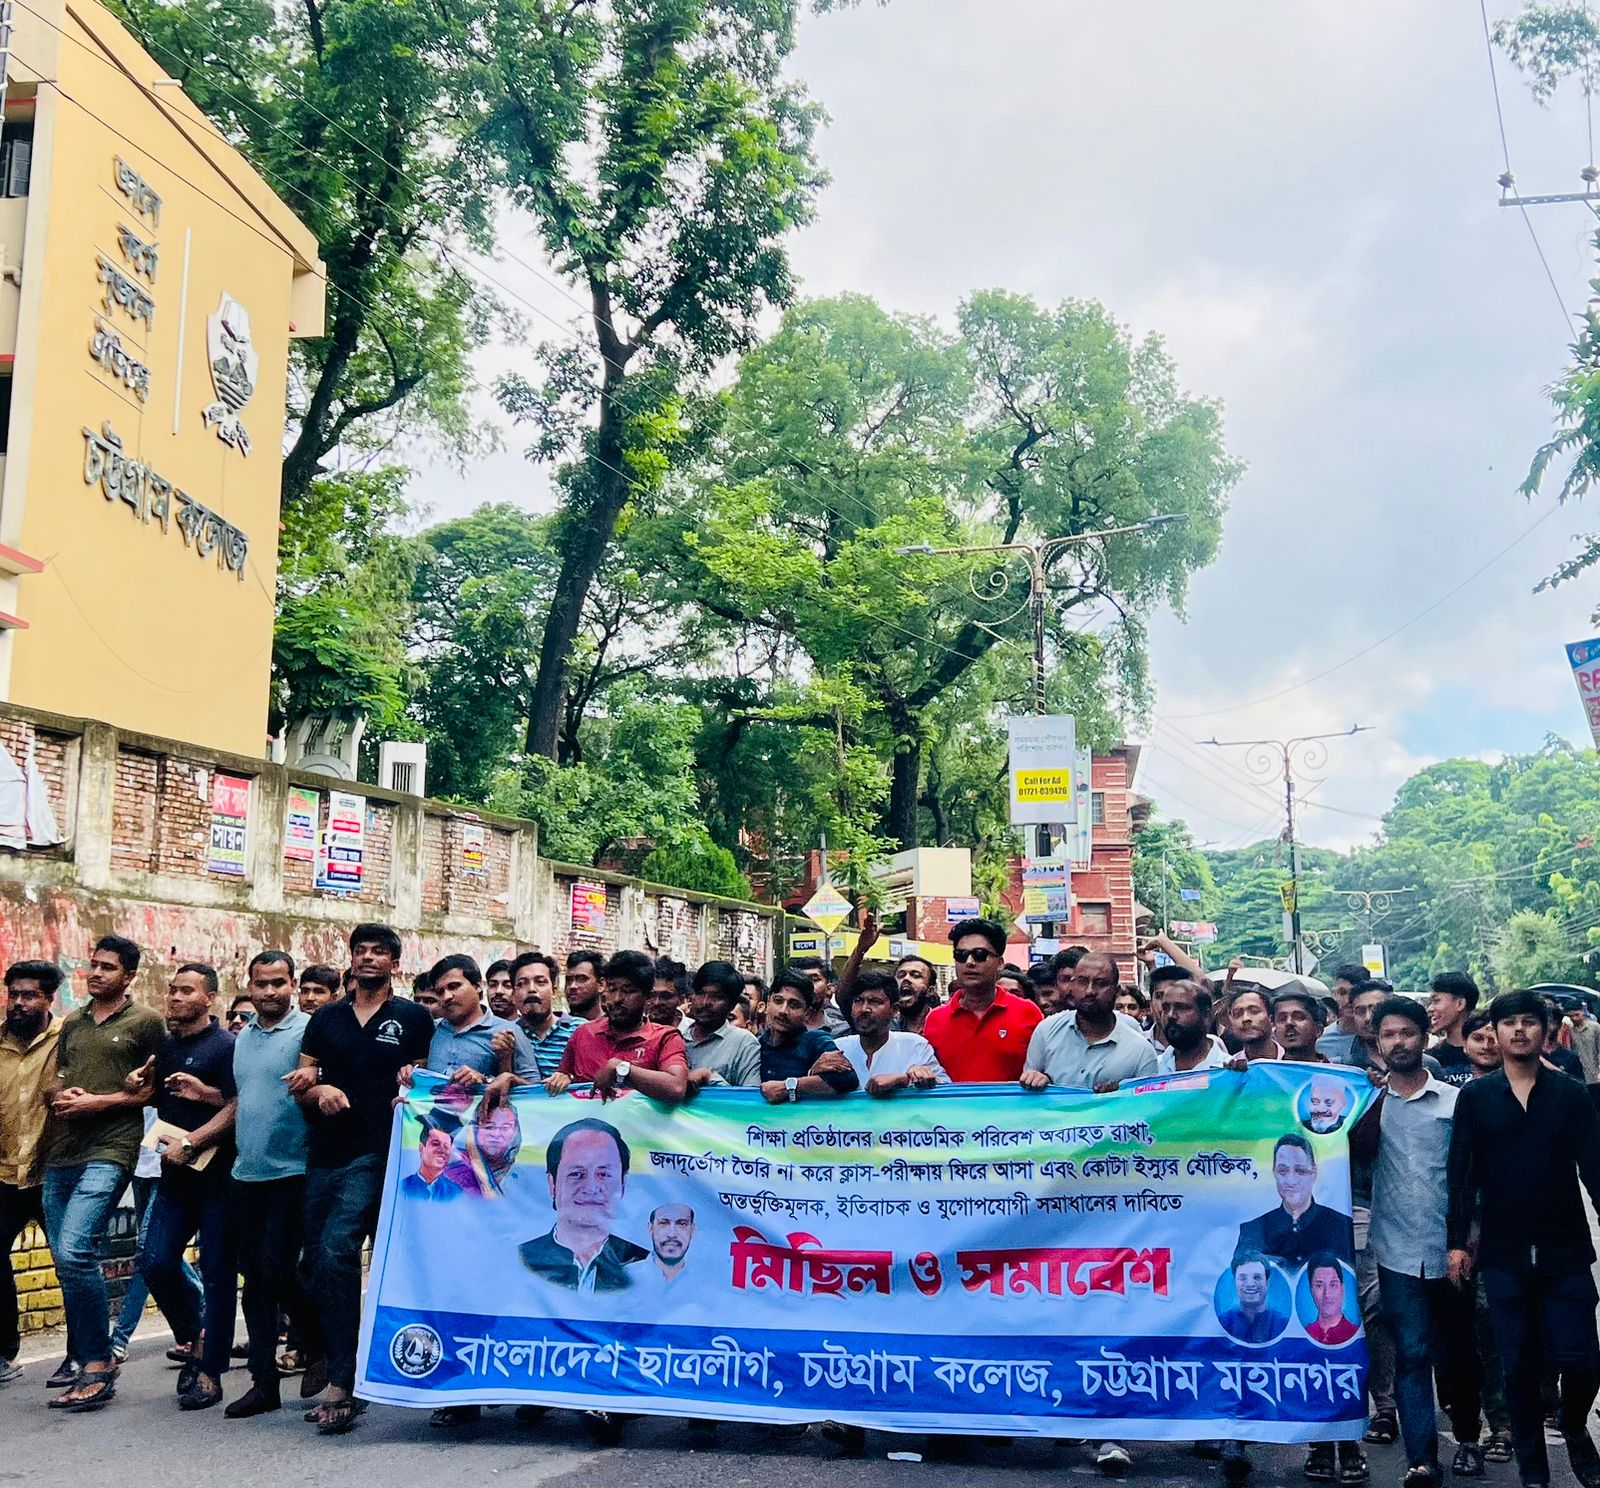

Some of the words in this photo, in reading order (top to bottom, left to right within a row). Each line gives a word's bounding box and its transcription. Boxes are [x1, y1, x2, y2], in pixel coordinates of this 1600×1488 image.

[81, 419, 174, 535] চট্টগ্রাম
[174, 488, 249, 582] কলেজ
[1024, 777, 1038, 785] Call
[1052, 776, 1061, 785] Ad
[746, 1125, 786, 1148] শিক্ষা
[792, 1124, 871, 1148] প্রতিষ্ঠানের
[878, 1125, 965, 1148] একাডেমিক
[971, 1125, 1033, 1147] পরিবেশ
[1039, 1125, 1104, 1147] অব্যাহত
[1110, 1122, 1154, 1145] রাখা,
[649, 1151, 727, 1177] জনদূর্ভোগ
[731, 1154, 770, 1180] তৈরি
[777, 1166, 793, 1181] না
[800, 1165, 834, 1182] করে
[839, 1159, 942, 1184] ক্লাস-পরীক্ষায়
[949, 1158, 987, 1180] ফিরে
[993, 1161, 1034, 1180] আসা
[1040, 1161, 1076, 1180] এবং
[1082, 1154, 1128, 1177] কোটা
[1133, 1154, 1179, 1181] ইস্যুর
[1186, 1151, 1258, 1179] যৌক্তিক,
[718, 1190, 830, 1220] অন্তর্ভুক্তিমূলক,
[836, 1195, 912, 1217] ইতিবাচক
[917, 1200, 930, 1215] ও
[935, 1191, 1031, 1220] যুগোপযোগী
[1036, 1194, 1117, 1215] সমাধানের
[1122, 1188, 1184, 1211] দাবিতে
[729, 1225, 893, 1299] মিছিল
[908, 1251, 943, 1296] ও
[955, 1247, 1172, 1297] সমাবেশ
[453, 1333, 625, 1380] বাংলাদেশ
[634, 1334, 784, 1398] ছাত্রলীগ,
[798, 1339, 922, 1394] চট্টগ্রাম
[929, 1356, 1062, 1407] কলেজ,
[1075, 1346, 1205, 1401] চট্টগ্রাম
[1212, 1356, 1364, 1407] মহানগর
